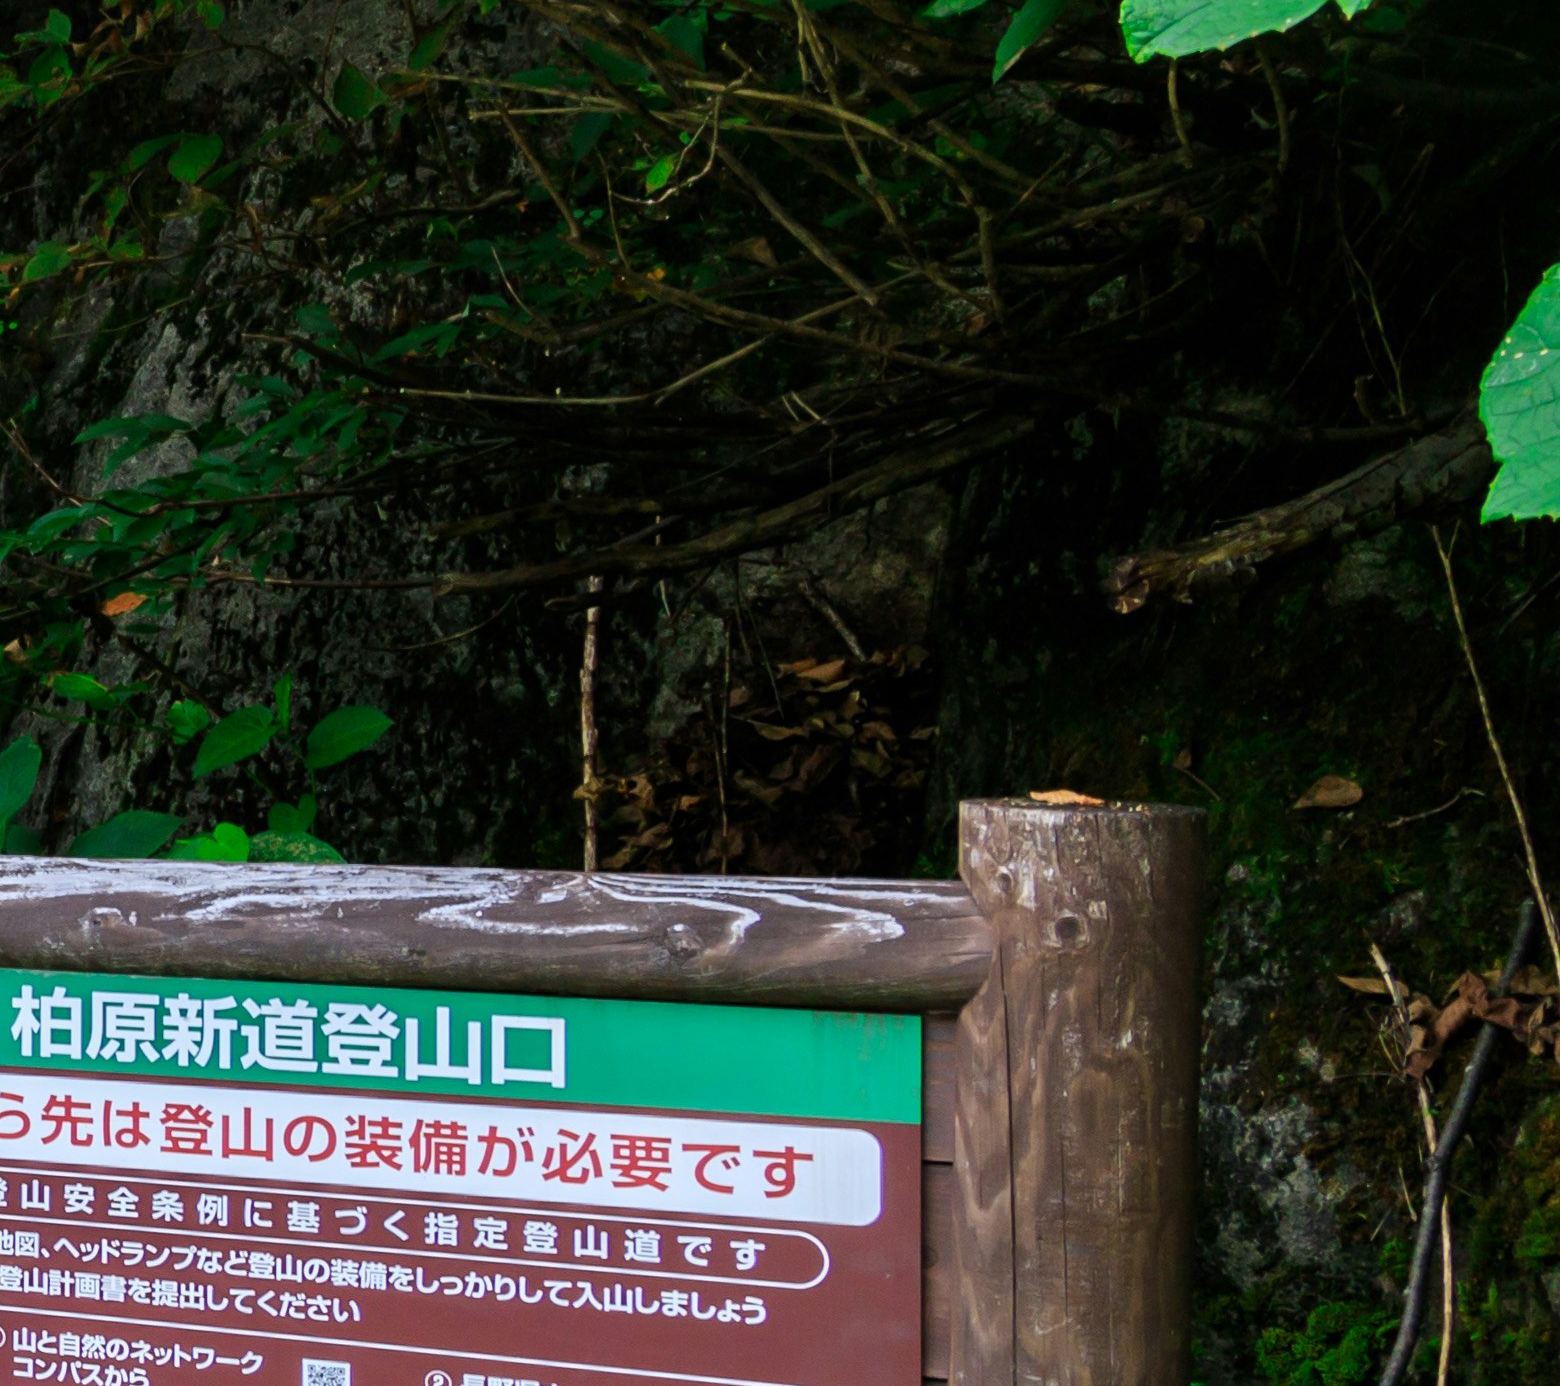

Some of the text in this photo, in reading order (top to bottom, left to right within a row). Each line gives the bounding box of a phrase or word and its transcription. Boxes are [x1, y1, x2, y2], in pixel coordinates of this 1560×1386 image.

[11, 985, 566, 1089] 柏原新道登山口
[12, 1328, 264, 1375] 山と自然のネットワーク
